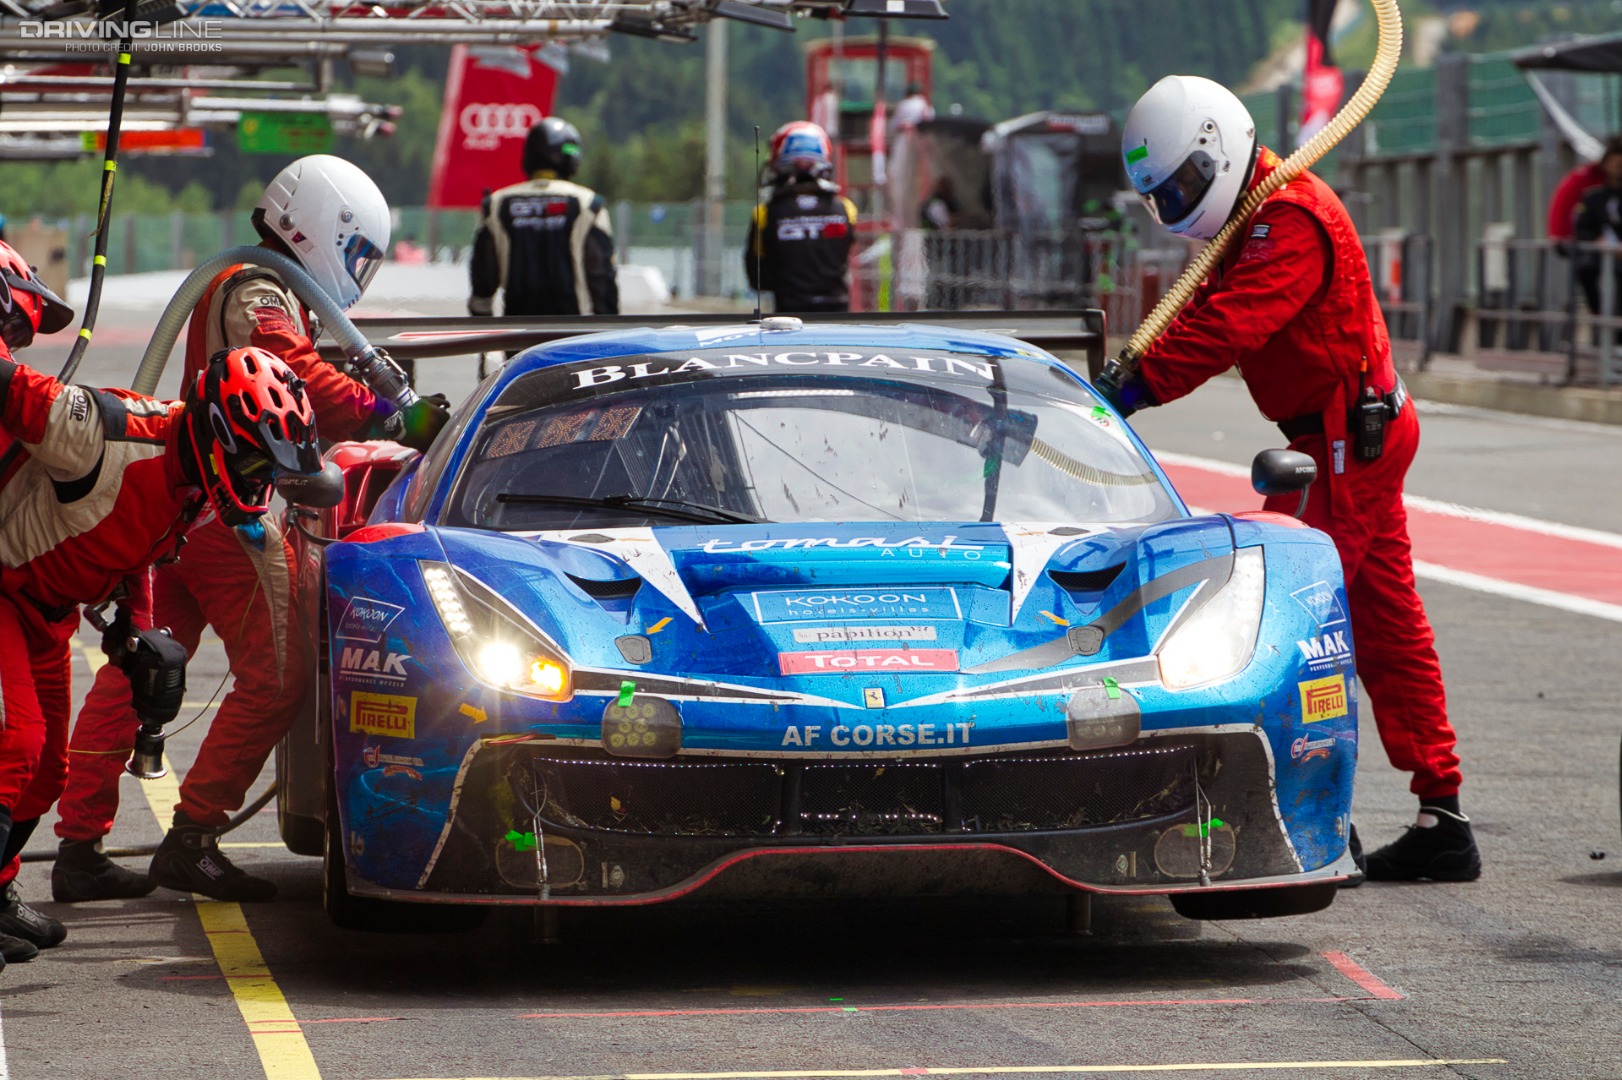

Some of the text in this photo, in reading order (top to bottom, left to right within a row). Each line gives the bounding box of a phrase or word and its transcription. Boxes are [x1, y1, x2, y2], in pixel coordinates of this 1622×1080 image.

[260, 296, 281, 307] OM
[570, 351, 998, 391] BLANCPAIN
[785, 593, 926, 607] KOKOON
[1296, 630, 1350, 660] MAK
[340, 646, 413, 676] MAK
[804, 654, 935, 669] TOTAL
[1305, 683, 1344, 715] PIRELLI
[355, 700, 409, 731] PIRELLI
[780, 722, 973, 747] AF CORSE.IT
